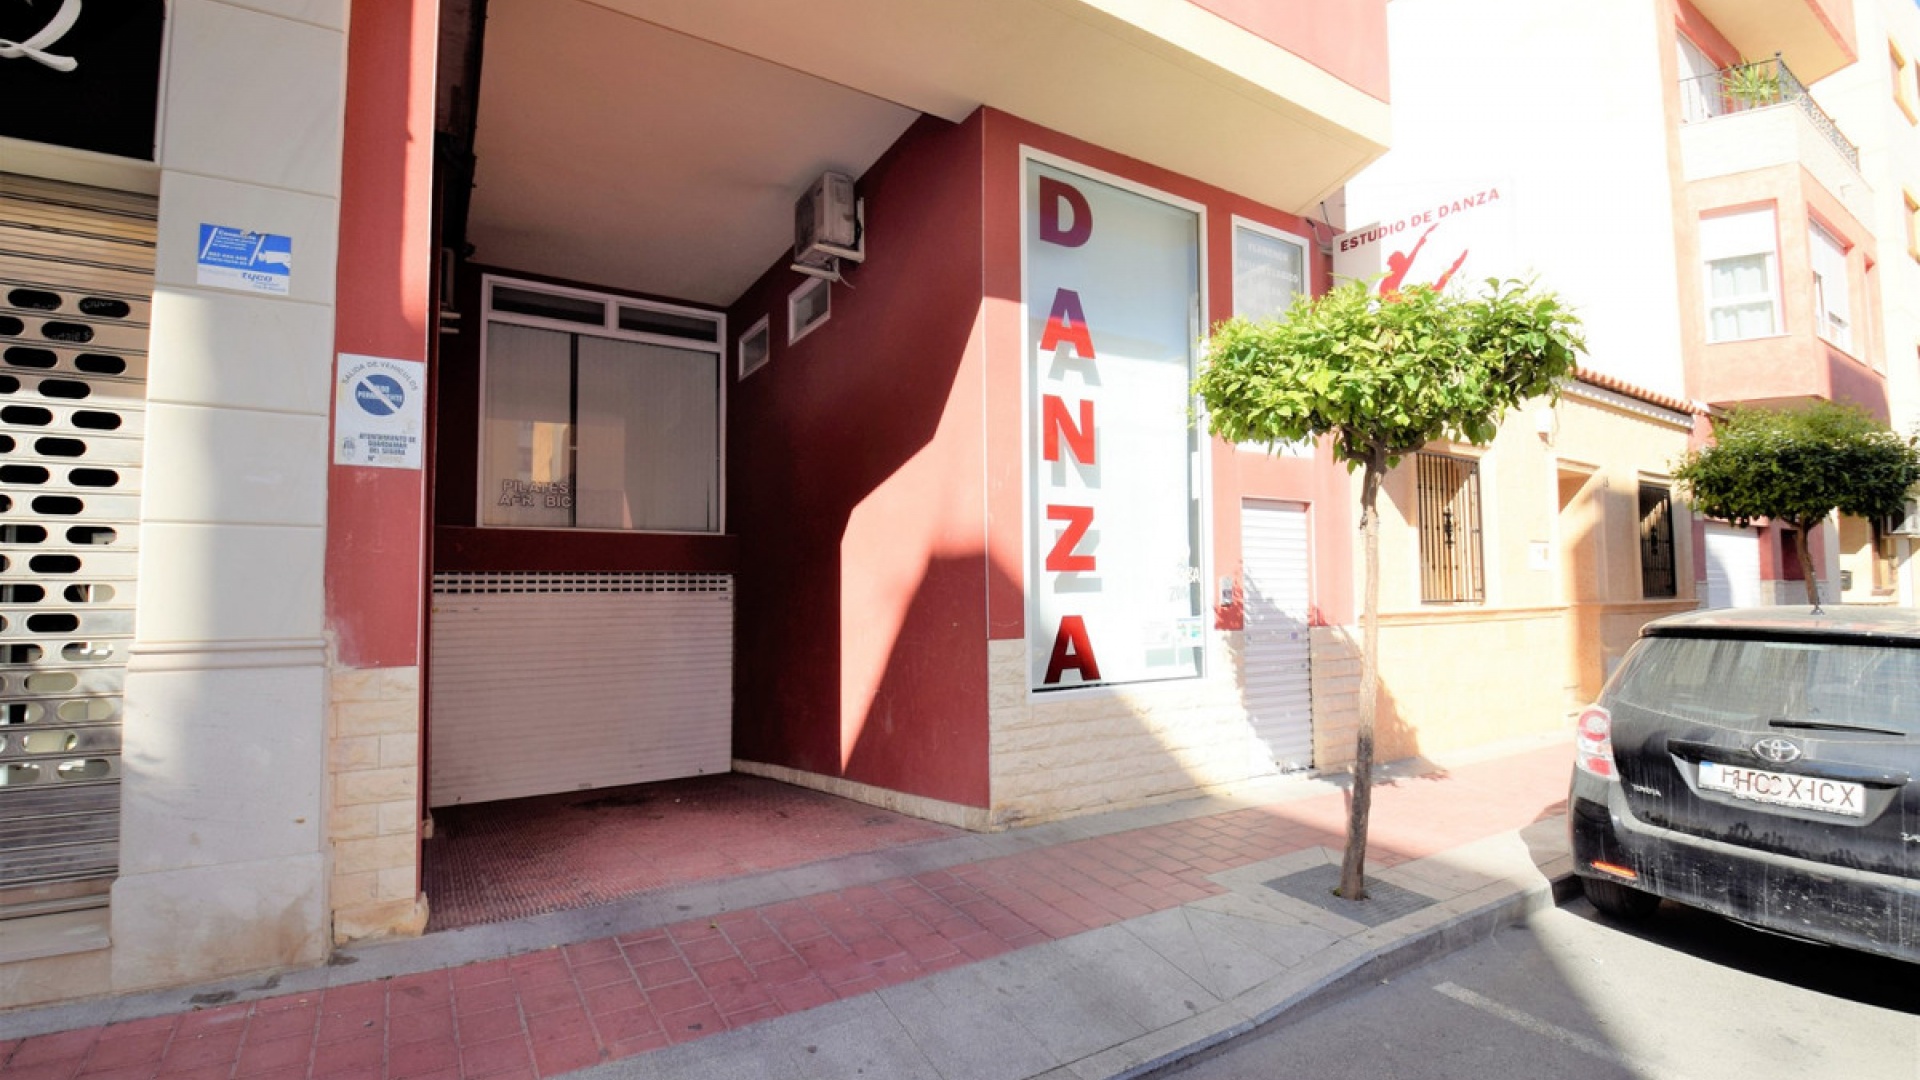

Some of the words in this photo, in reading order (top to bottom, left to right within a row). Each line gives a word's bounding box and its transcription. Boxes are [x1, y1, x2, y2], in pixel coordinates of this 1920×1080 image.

[1340, 220, 1406, 253] ESTUDIO
[1410, 210, 1433, 228] DE
[1437, 188, 1500, 219] DANZA
[342, 363, 366, 385] SALIDA
[366, 360, 378, 368] DE
[1038, 175, 1101, 685] DANZA
[502, 478, 570, 495] PILATES
